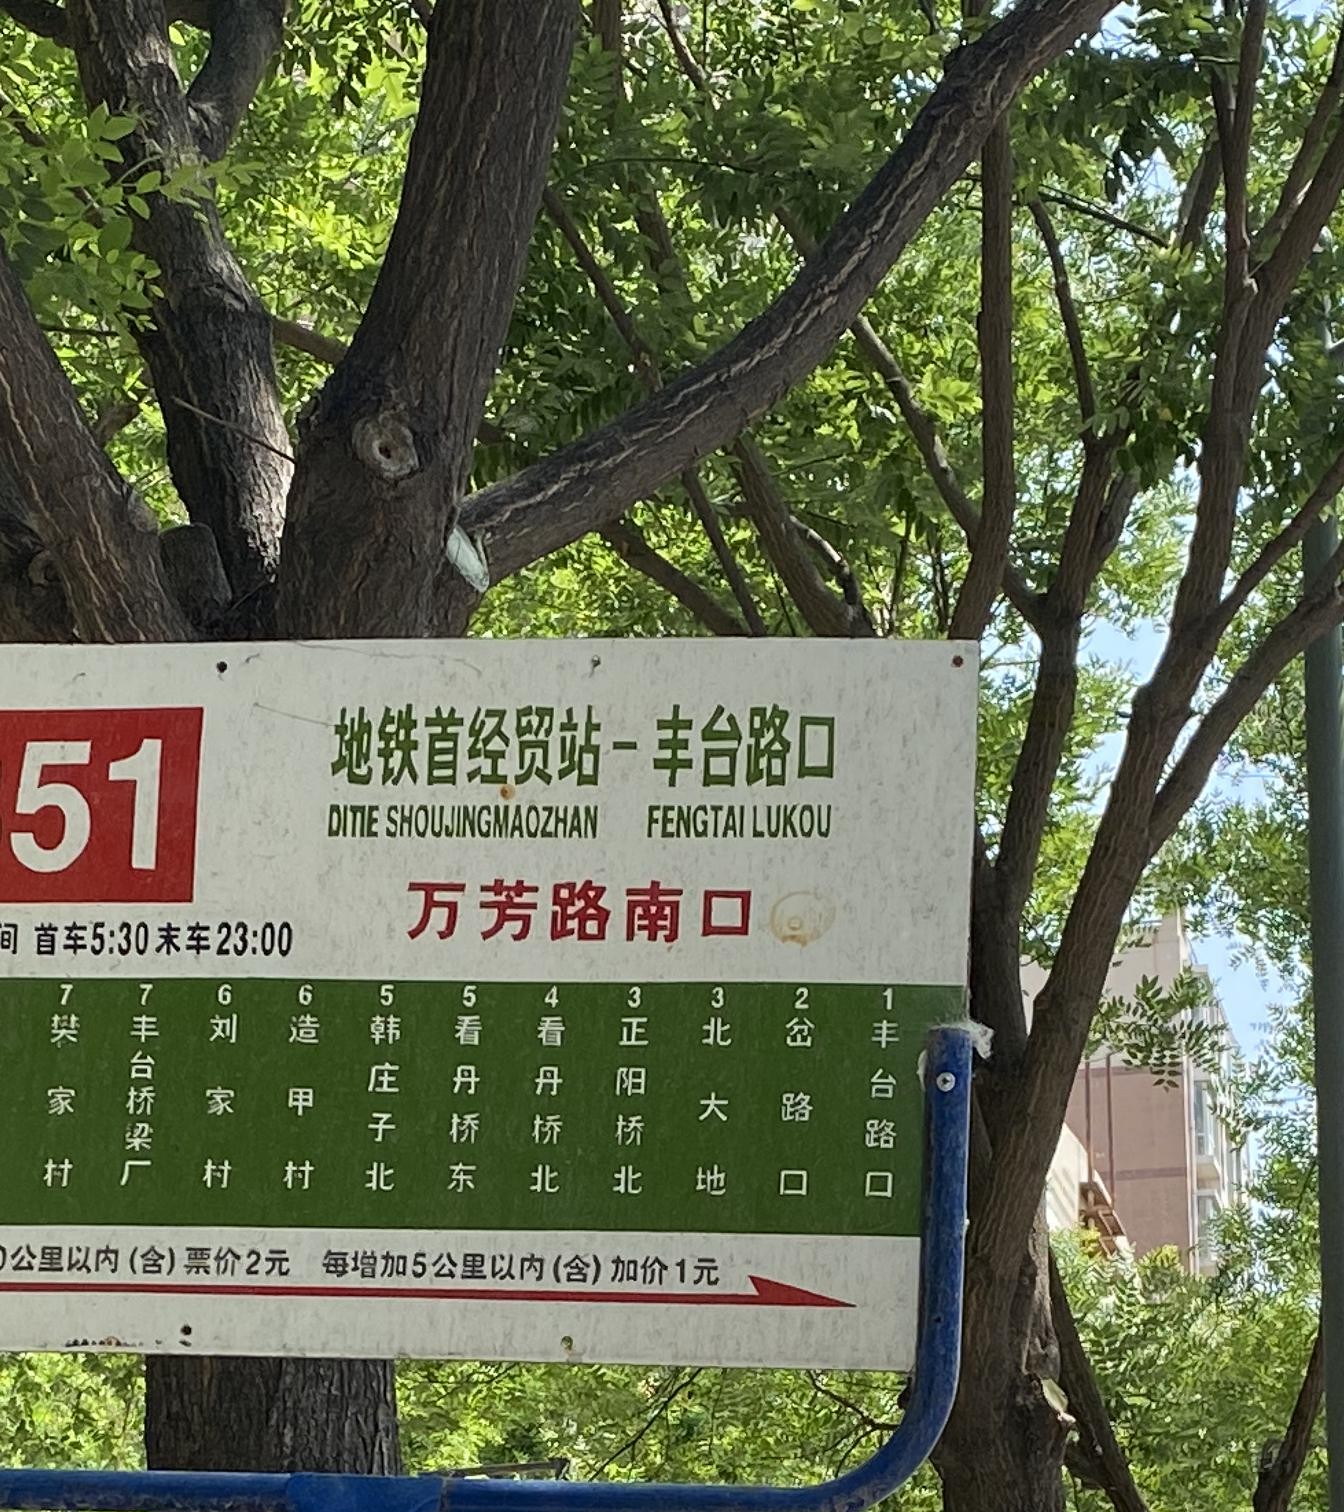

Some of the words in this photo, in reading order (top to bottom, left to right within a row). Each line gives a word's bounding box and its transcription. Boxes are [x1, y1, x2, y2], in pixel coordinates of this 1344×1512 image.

[327, 804, 378, 839] DITIE
[385, 804, 598, 839] SHOUJINGMAOZHAN
[647, 804, 744, 839] FENGTAI
[753, 804, 831, 839] LUKOU
[407, 879, 752, 942] 万芳路南口
[60, 984, 73, 1005] 7
[139, 984, 153, 1005] 7
[218, 984, 232, 1005] 6
[298, 984, 312, 1006] 6
[380, 984, 394, 1006] 5
[462, 985, 477, 1007] 5
[544, 985, 558, 1008] 4
[627, 986, 641, 1008] 3
[711, 986, 724, 1008] 3
[794, 987, 809, 1009] 2
[882, 987, 892, 1010] 1
[120, 1014, 159, 1186] 丰台桥梁厂
[203, 1013, 238, 1188] 刘家村
[283, 1013, 320, 1190] 造甲村
[364, 1014, 401, 1191] 韩庄子北
[448, 1015, 482, 1192] 看丹桥东
[530, 1016, 565, 1193] 看丹桥北
[613, 1017, 650, 1194] 正阳桥北
[696, 1017, 731, 1195] 北大地
[779, 1017, 815, 1196] 岔路口
[865, 1019, 899, 1198] 丰台路口
